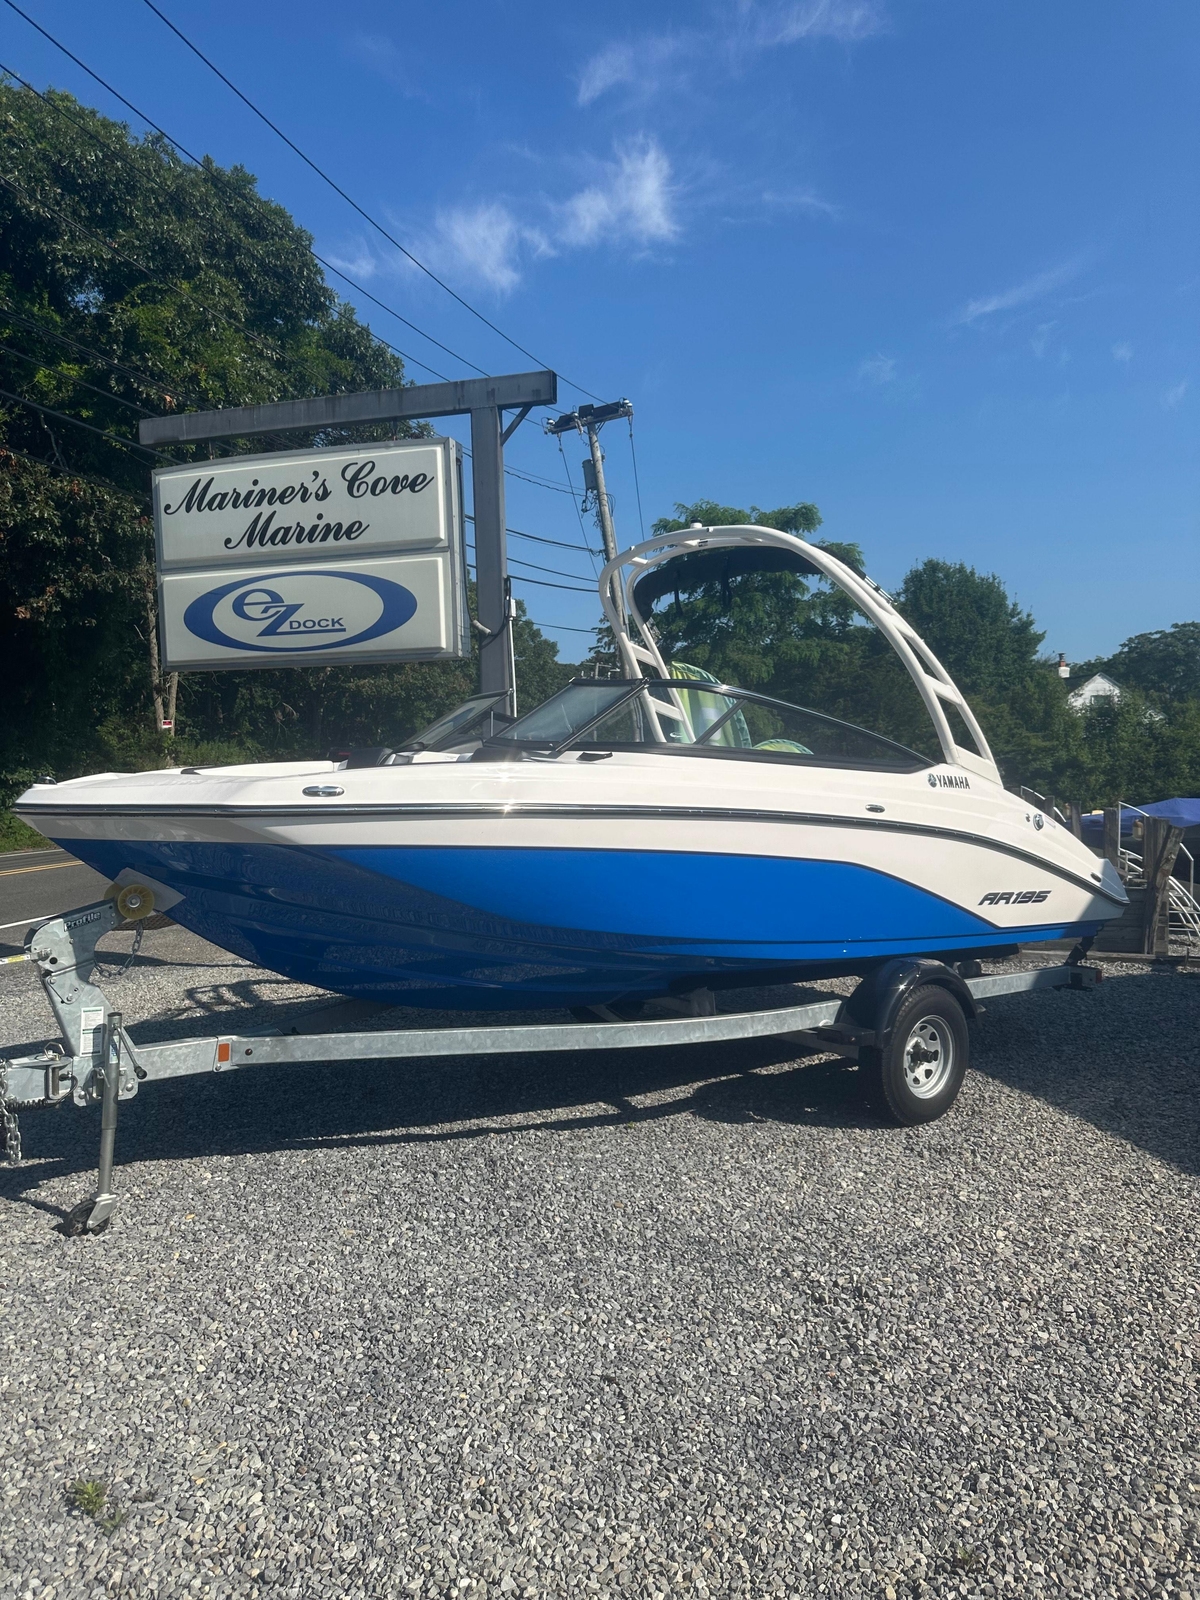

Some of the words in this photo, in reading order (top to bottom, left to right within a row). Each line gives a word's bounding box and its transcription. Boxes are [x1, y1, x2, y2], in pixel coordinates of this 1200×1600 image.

[164, 470, 332, 515] Mariner's
[340, 460, 435, 499] Cove
[224, 510, 370, 549] Marine
[289, 617, 345, 630] DOCK
[936, 774, 970, 790] YAMAHA
[977, 890, 1052, 906] AR195
[64, 912, 101, 931] Profile
